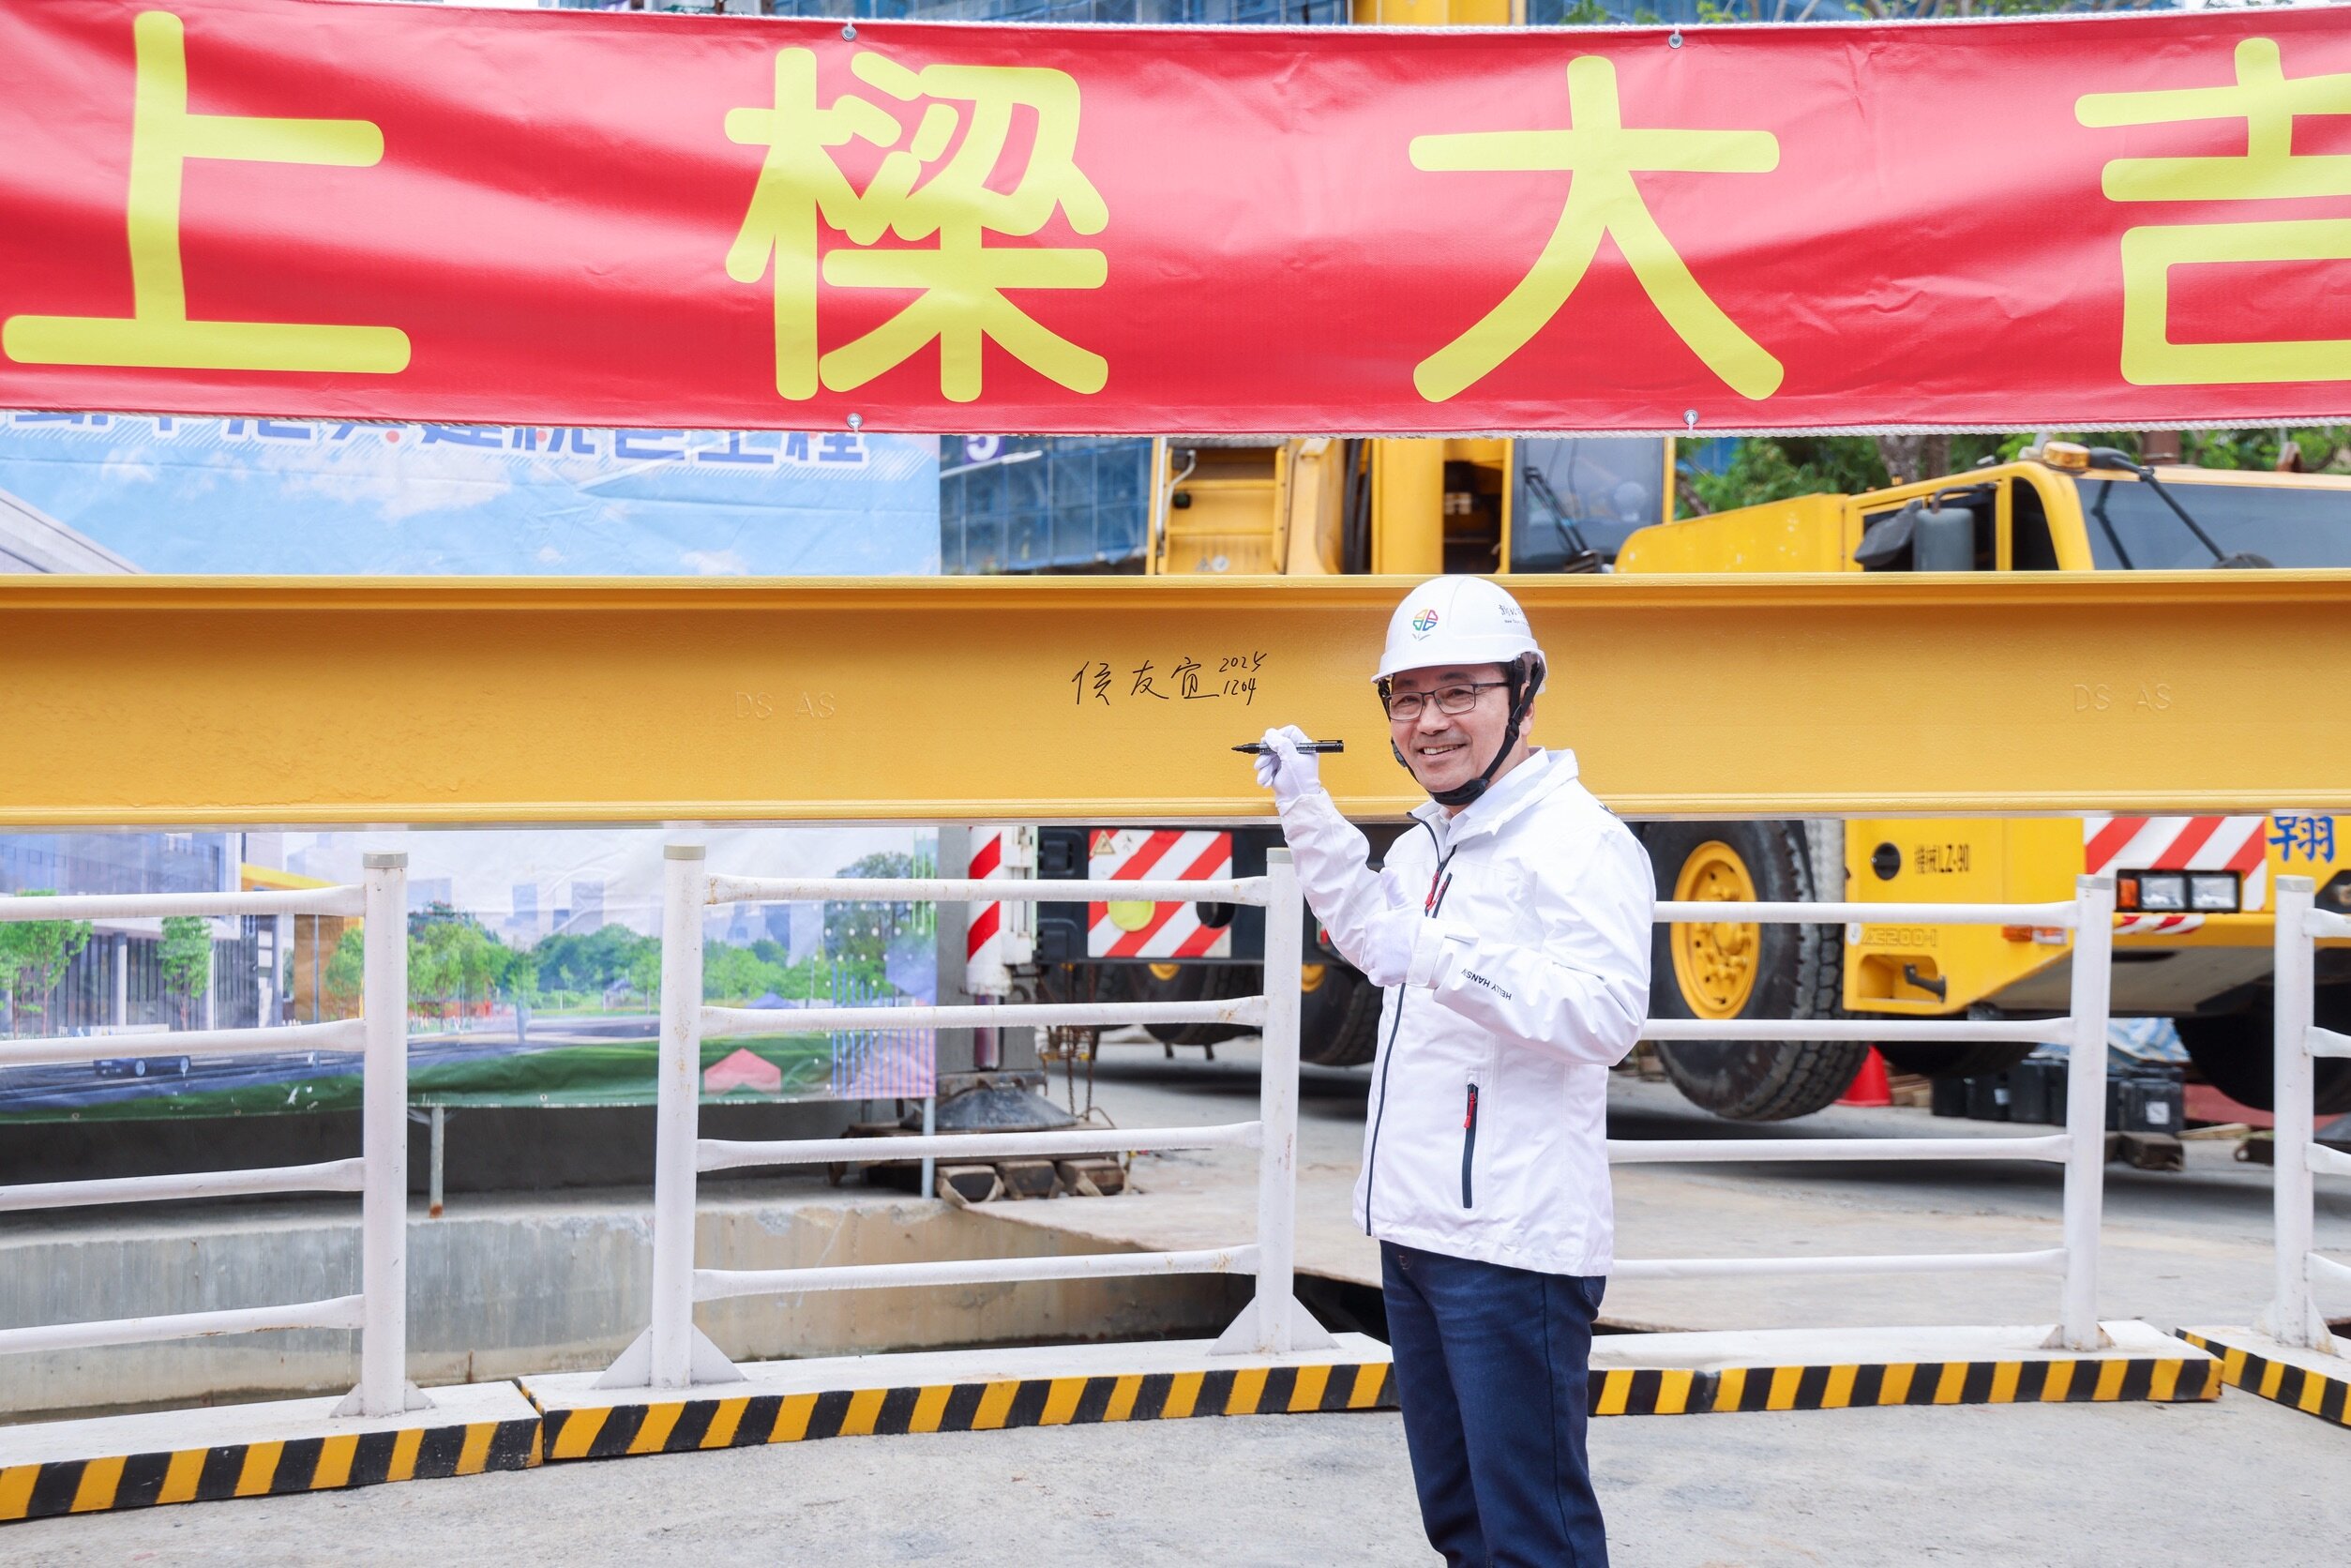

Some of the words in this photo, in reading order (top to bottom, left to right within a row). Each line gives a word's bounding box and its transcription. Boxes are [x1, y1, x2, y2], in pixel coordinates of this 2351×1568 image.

[1219, 651, 1267, 672] 2025
[1072, 656, 1219, 705] 侯友宜
[1223, 678, 1257, 705] 1204
[735, 690, 773, 719] DS
[795, 690, 835, 719] AS
[2073, 684, 2110, 712] DS
[2133, 684, 2173, 712] AS
